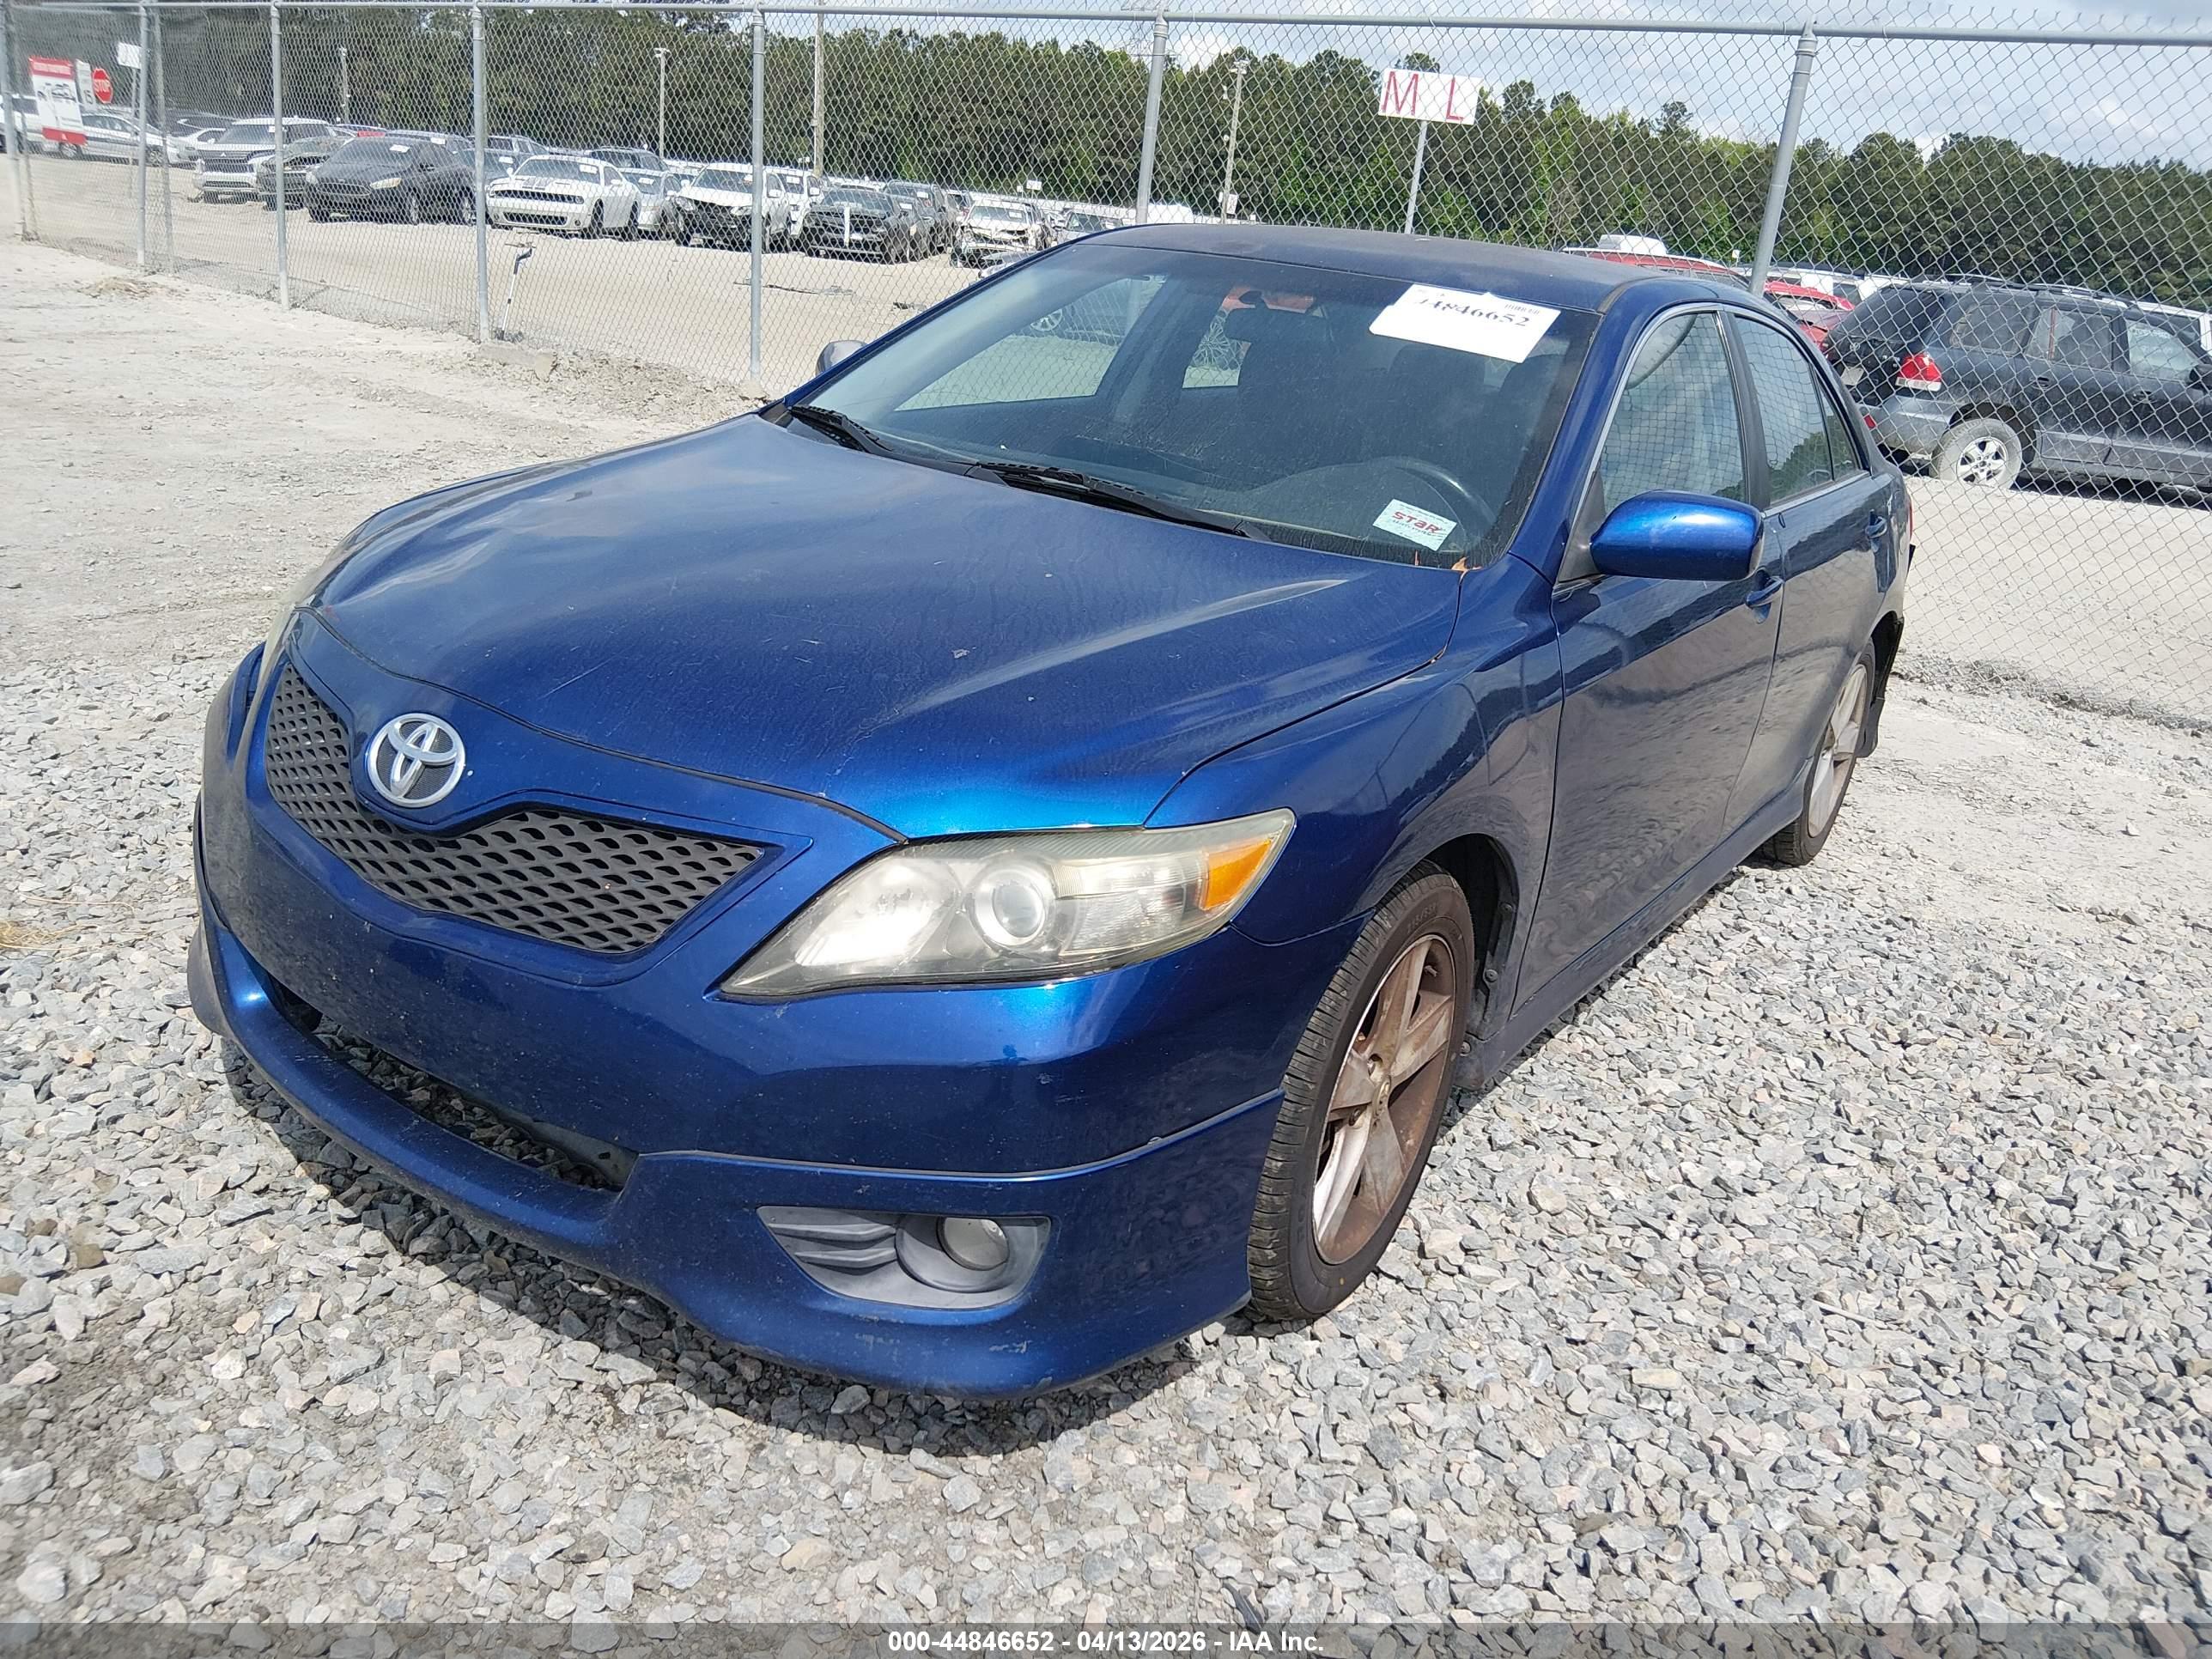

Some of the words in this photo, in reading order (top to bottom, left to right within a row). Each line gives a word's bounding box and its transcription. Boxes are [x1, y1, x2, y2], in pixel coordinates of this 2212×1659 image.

[94, 78, 112, 94] STOP
[1381, 70, 1419, 116] M
[1446, 76, 1463, 121] L
